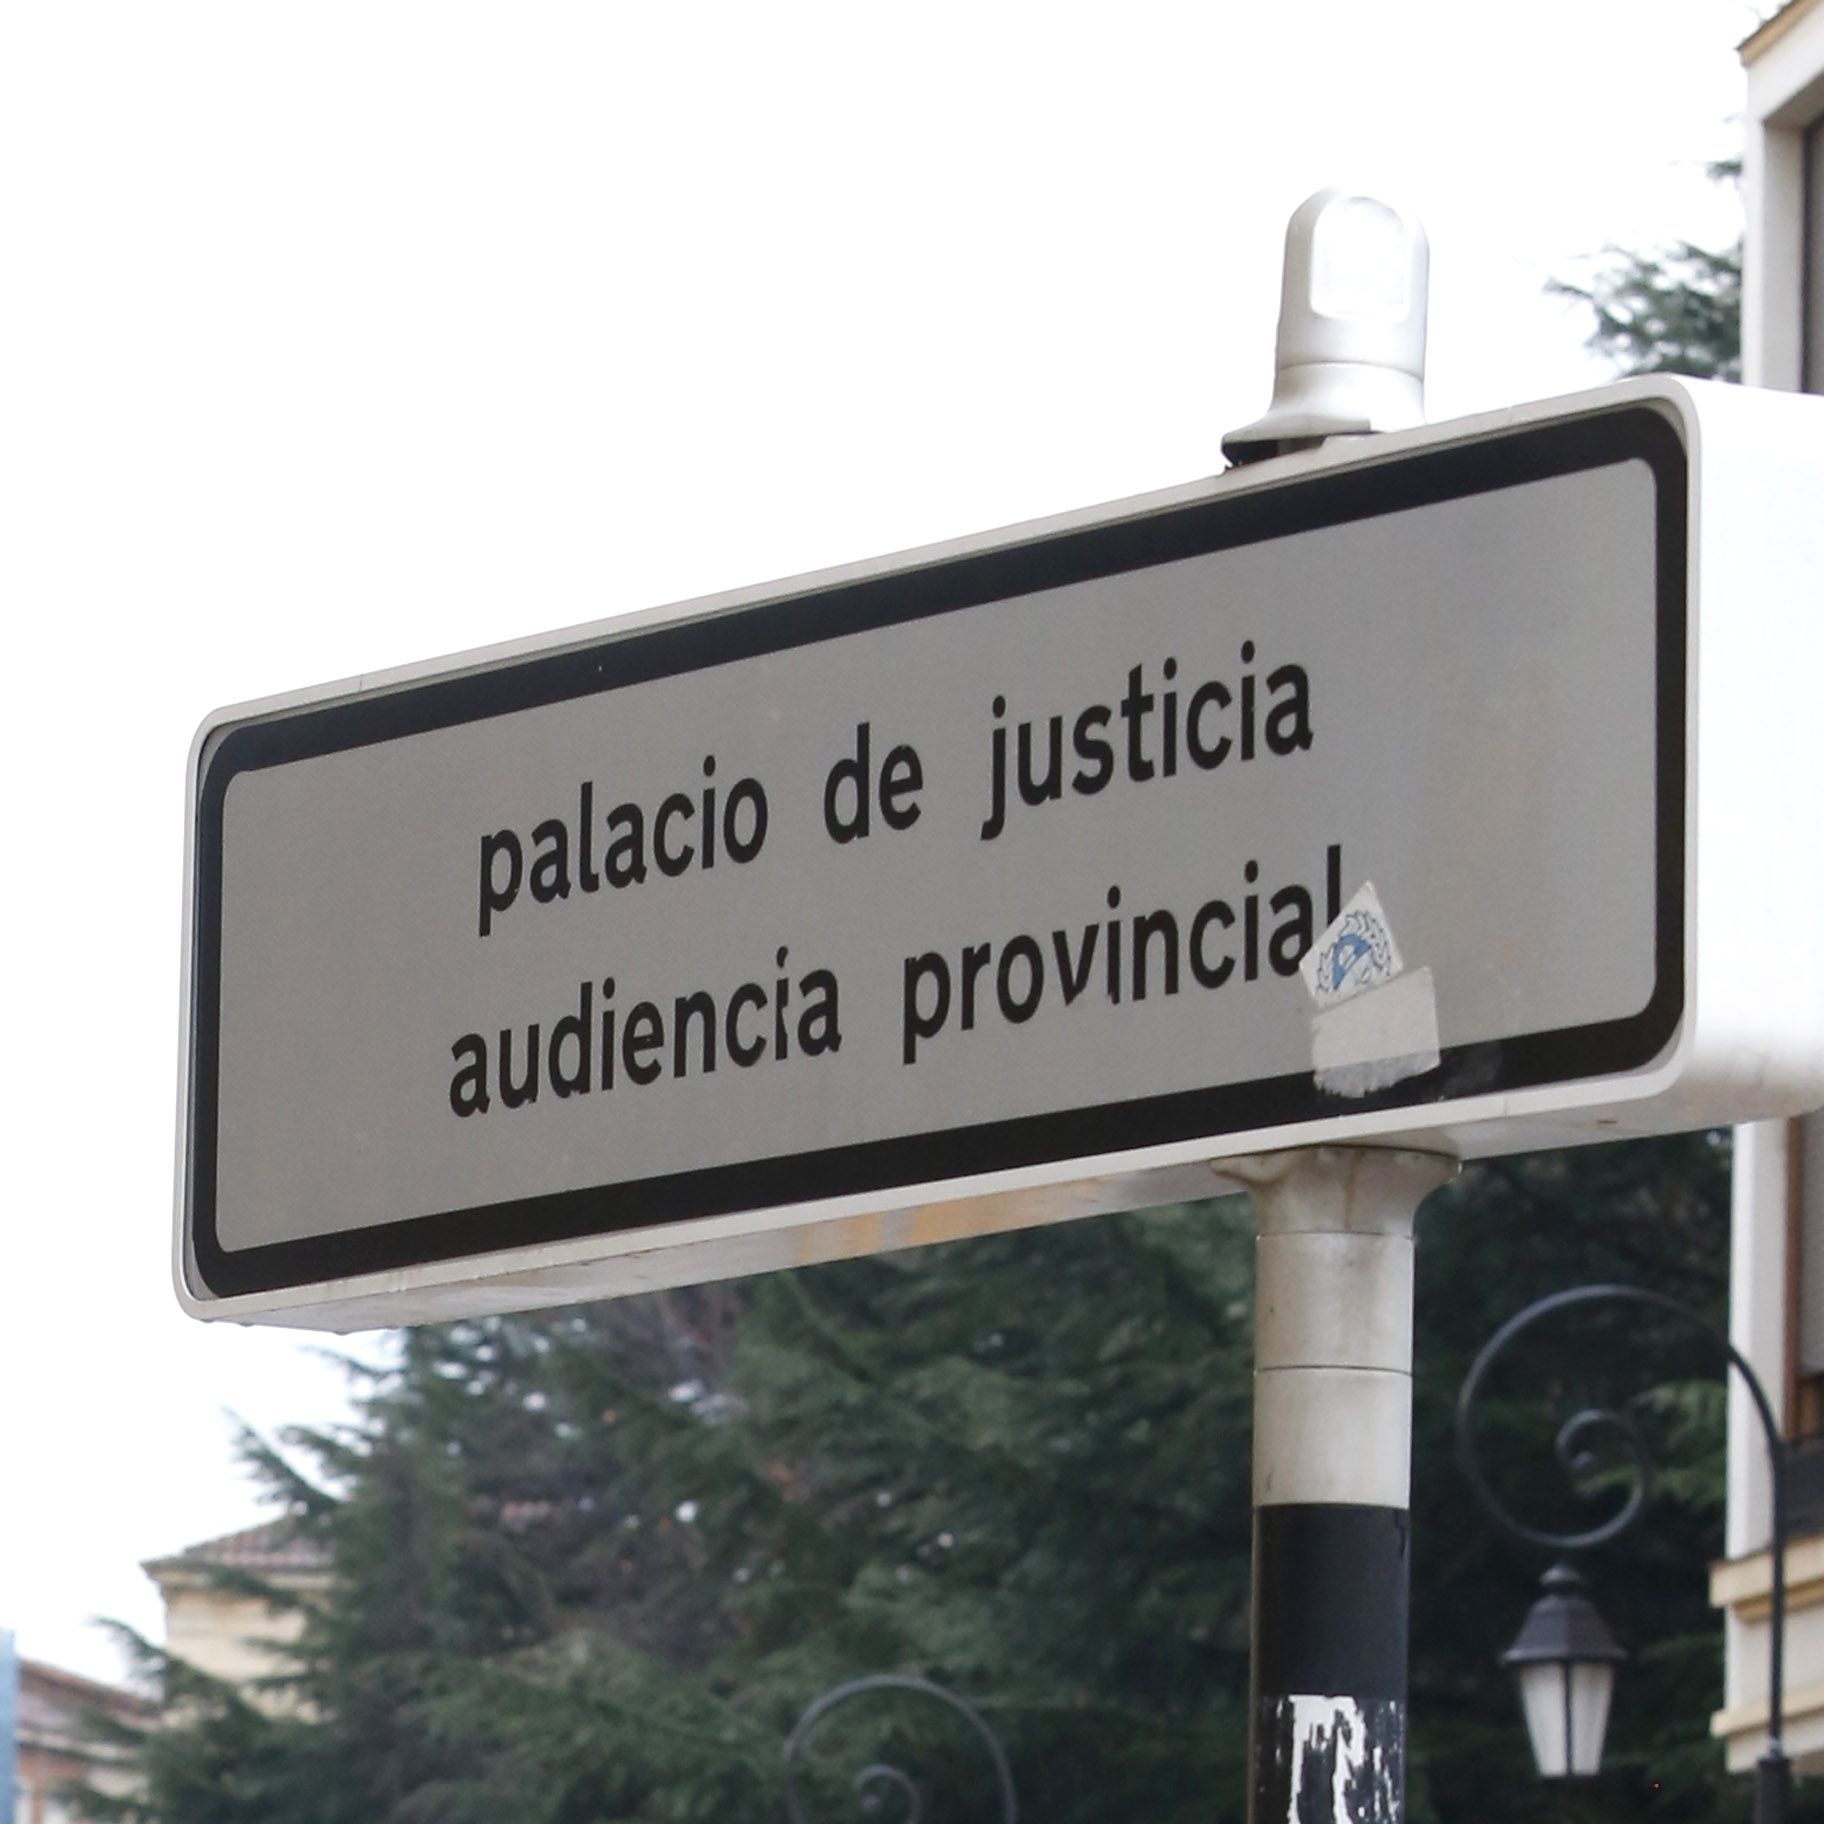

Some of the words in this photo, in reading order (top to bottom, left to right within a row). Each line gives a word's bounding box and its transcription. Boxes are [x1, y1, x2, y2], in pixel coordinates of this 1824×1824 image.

[478, 755, 769, 938] palacio
[823, 721, 924, 845] de
[980, 640, 1314, 841] justicia
[449, 945, 843, 1118] audiencia
[903, 844, 1342, 1065] provincial
